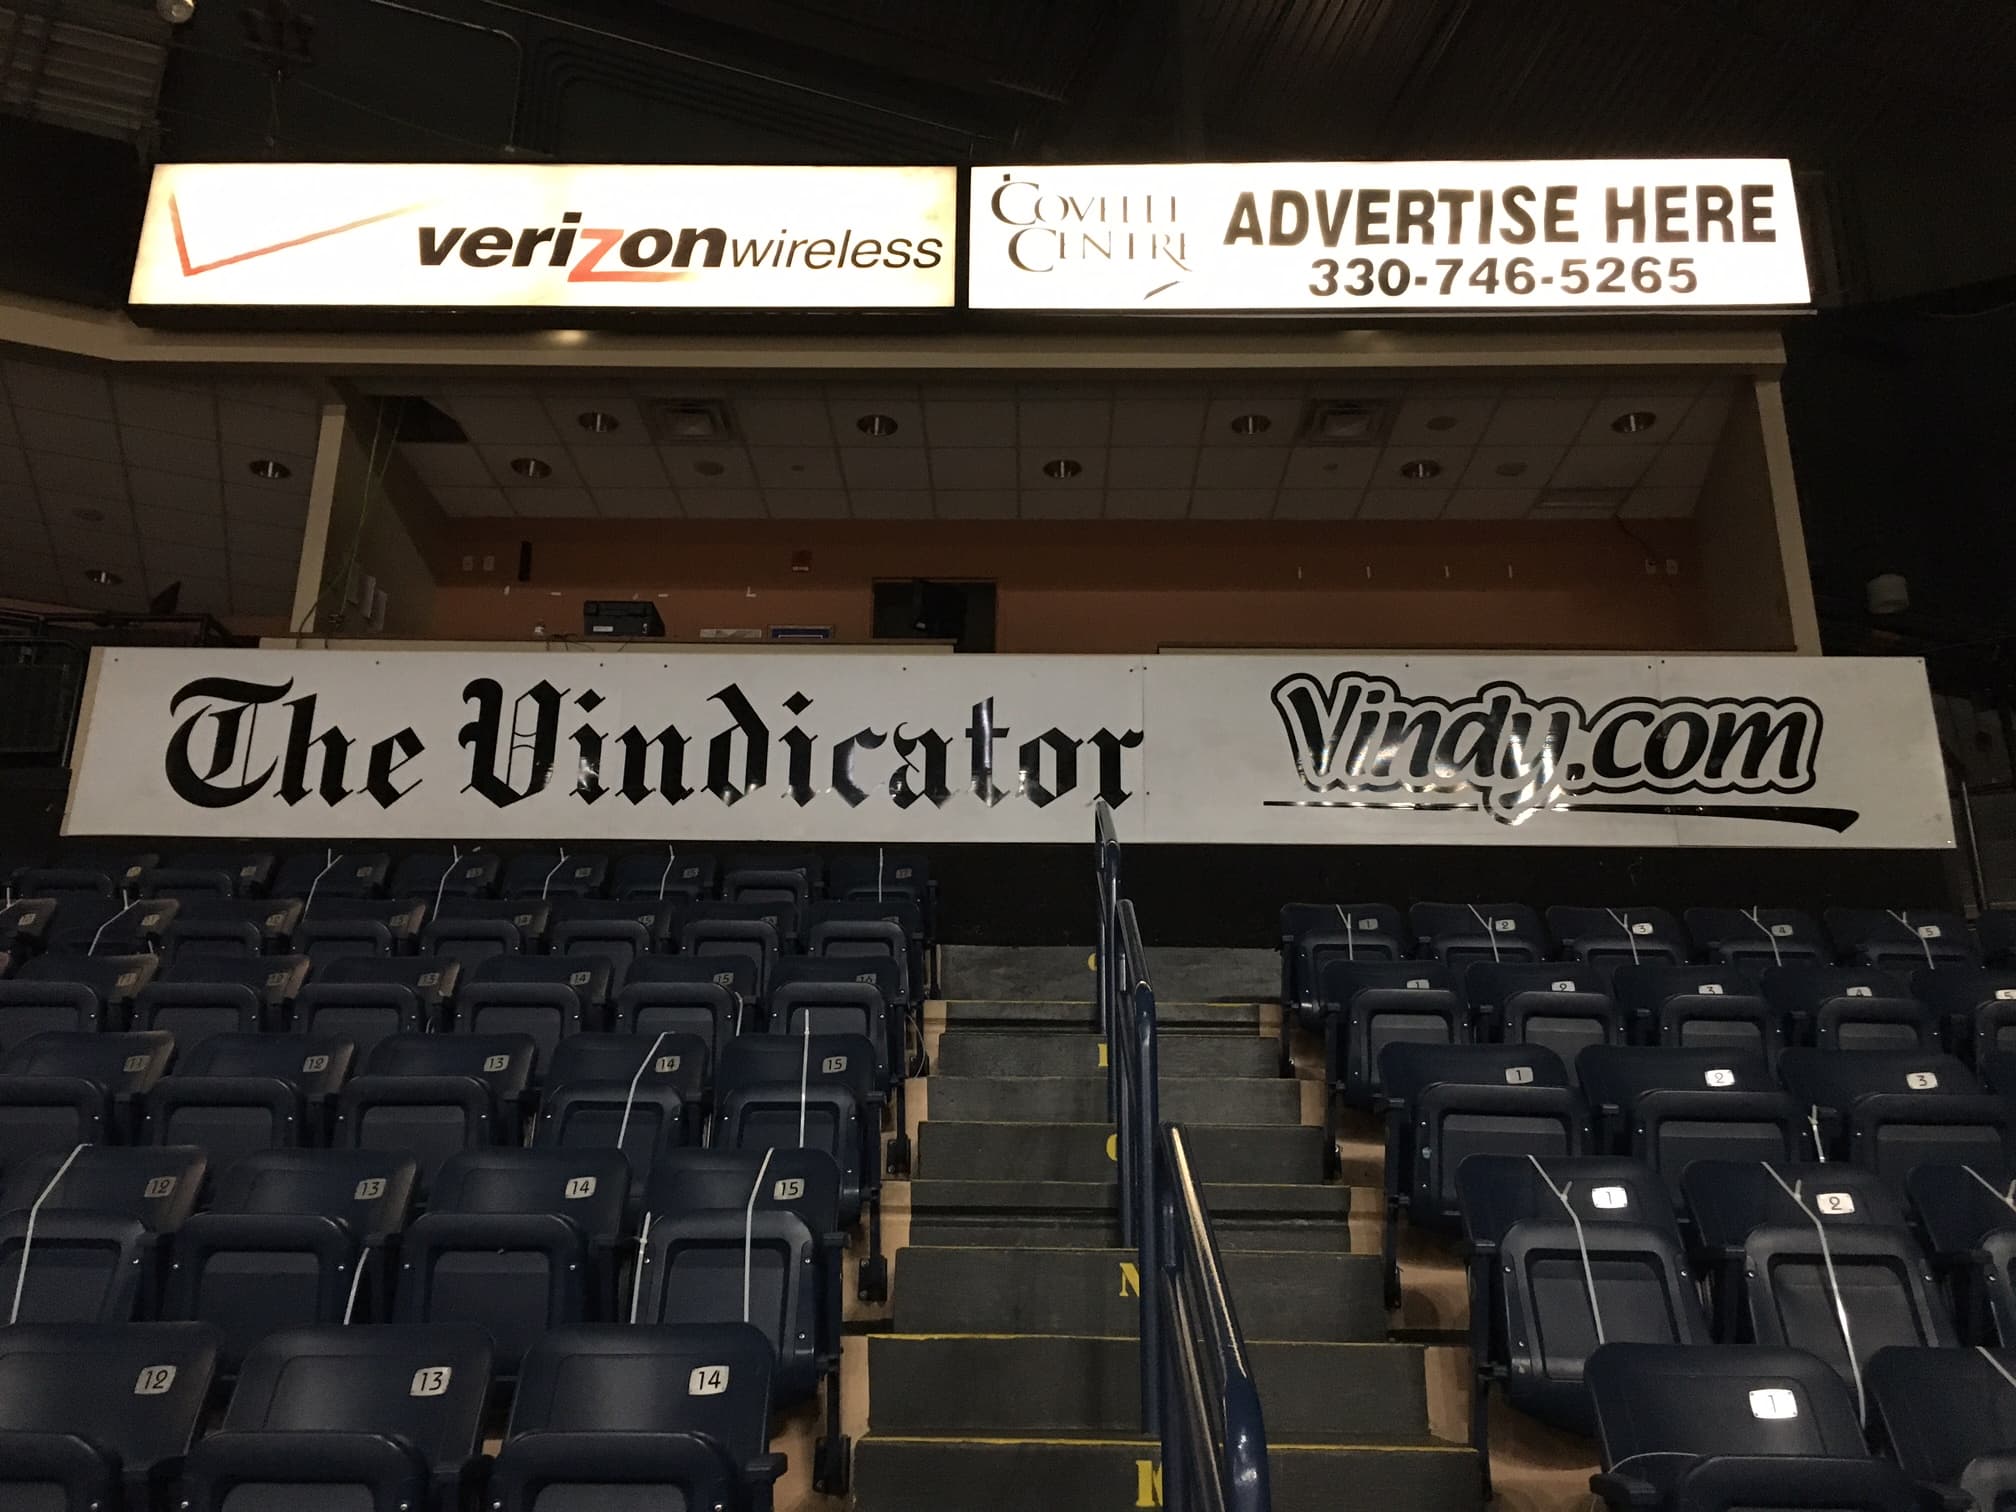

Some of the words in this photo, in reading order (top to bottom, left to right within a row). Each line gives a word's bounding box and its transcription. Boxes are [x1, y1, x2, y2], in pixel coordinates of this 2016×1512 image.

[1224, 185, 1579, 247] ADVERTISE
[1605, 184, 1776, 244] HERE
[418, 212, 726, 282] verizon
[730, 229, 944, 270] wireless
[1308, 257, 1698, 297] 330-746-5265
[165, 676, 425, 809] The
[458, 678, 1145, 810] Vindicator
[1271, 671, 1823, 825] Vindy.com
[309, 1057, 323, 1070] 12
[661, 1058, 674, 1071] 14
[828, 1058, 842, 1071] 15
[1915, 1074, 1927, 1087] 3
[152, 1179, 170, 1194] 12
[362, 1181, 379, 1196] 13
[573, 1180, 589, 1196] 14
[781, 1181, 798, 1196] 15
[1829, 1196, 1843, 1211] 2
[144, 1369, 168, 1390] 12
[421, 1371, 443, 1391] 13
[698, 1369, 720, 1391] 14
